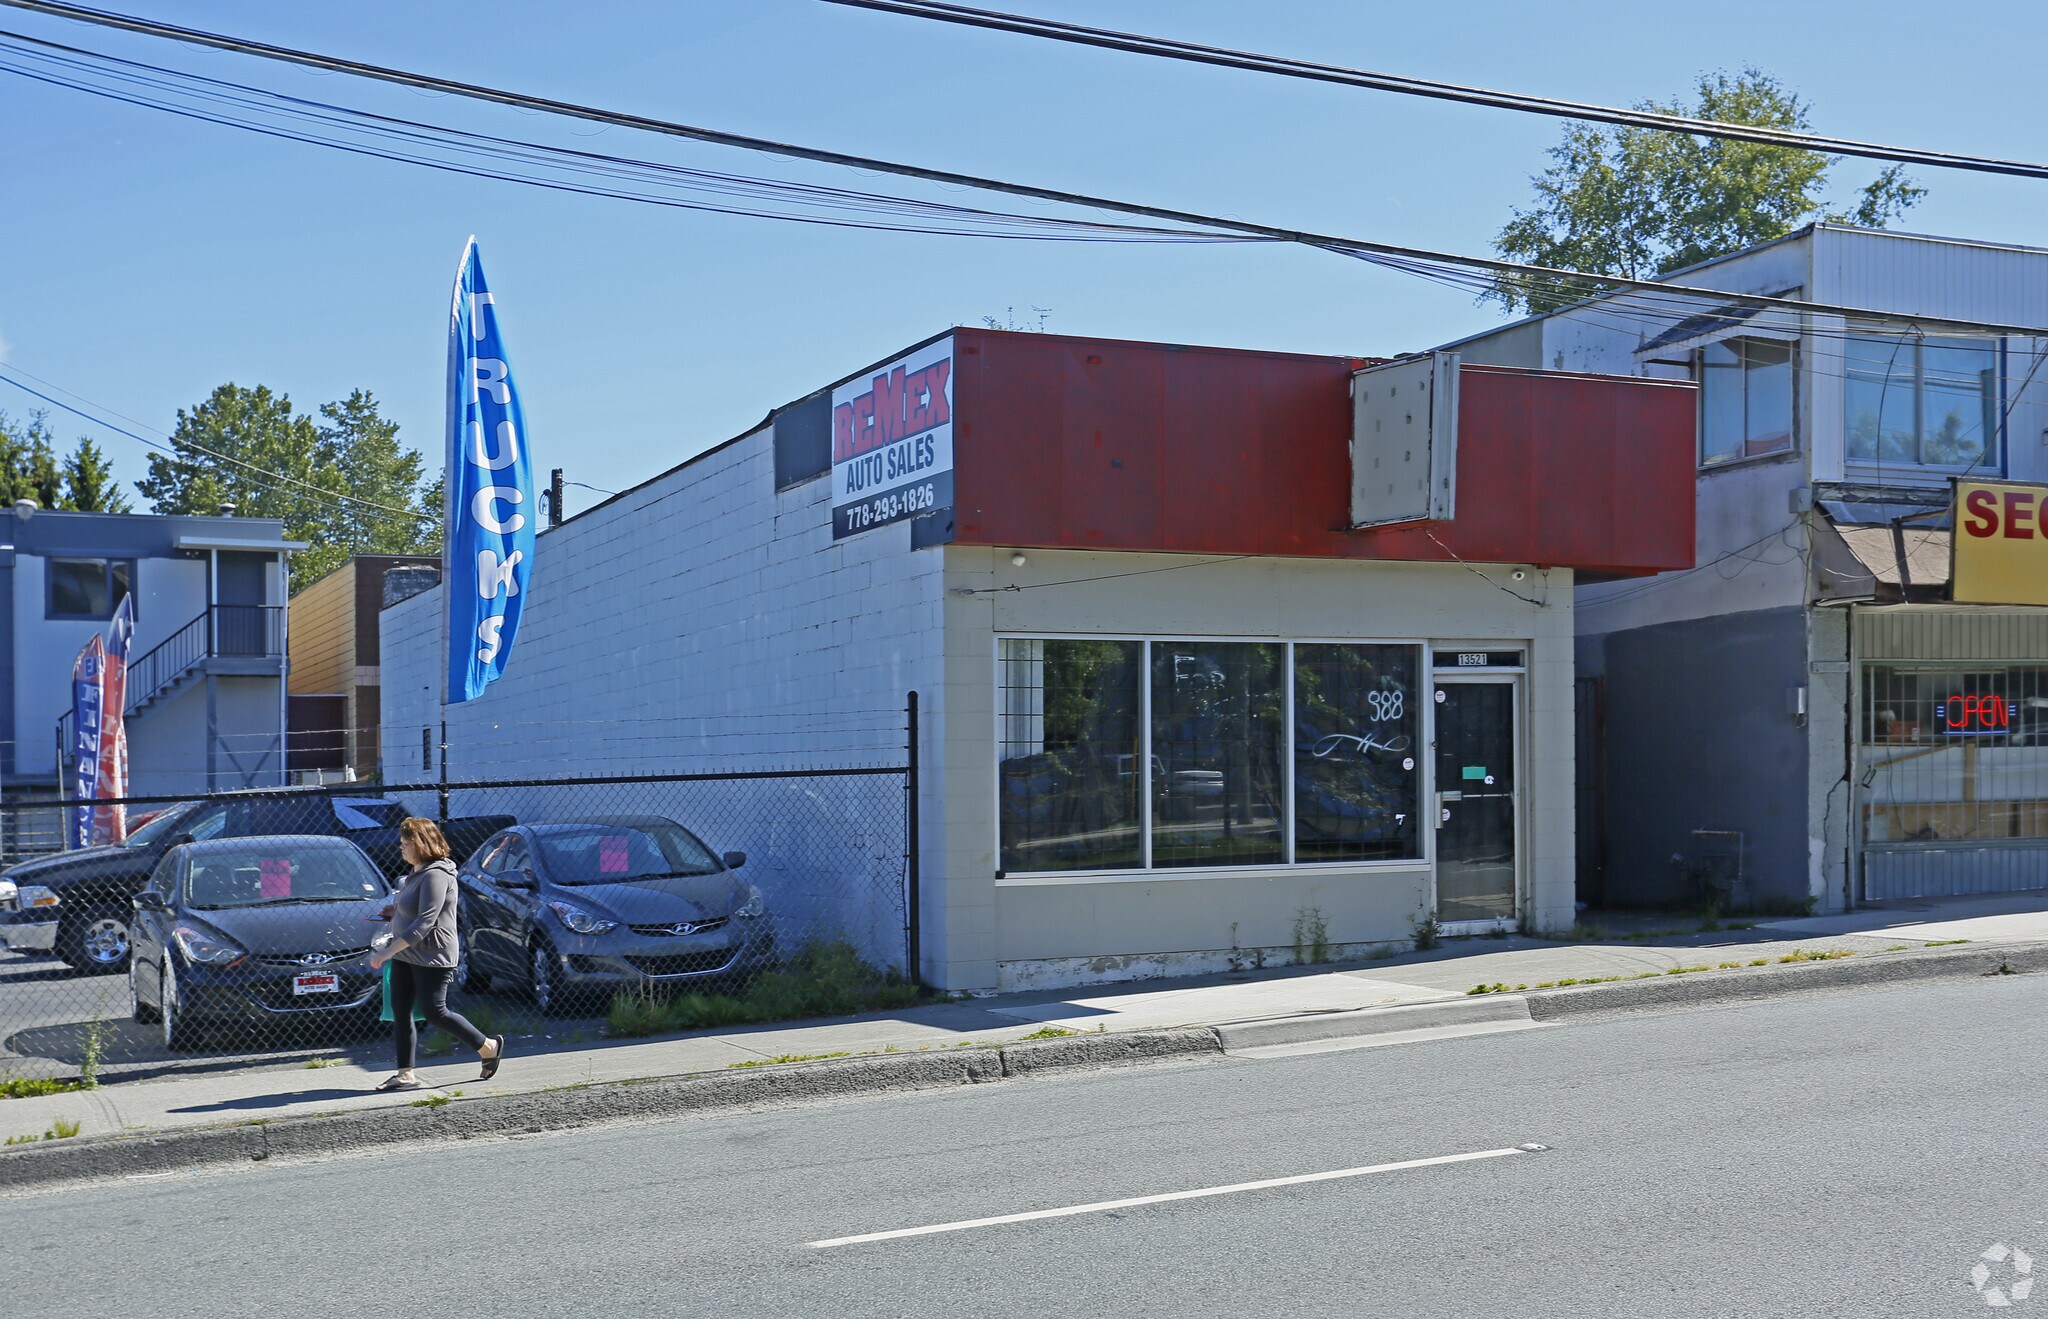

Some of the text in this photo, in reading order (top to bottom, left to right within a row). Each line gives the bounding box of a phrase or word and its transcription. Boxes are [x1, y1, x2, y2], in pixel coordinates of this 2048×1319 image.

[465, 291, 526, 665] TRUCKS
[846, 433, 934, 495] AUTO SALES
[846, 482, 934, 530] 778-293-1826
[1964, 489, 2048, 540] SE
[1459, 654, 1486, 665] 13521
[1947, 695, 2009, 727] OPEN
